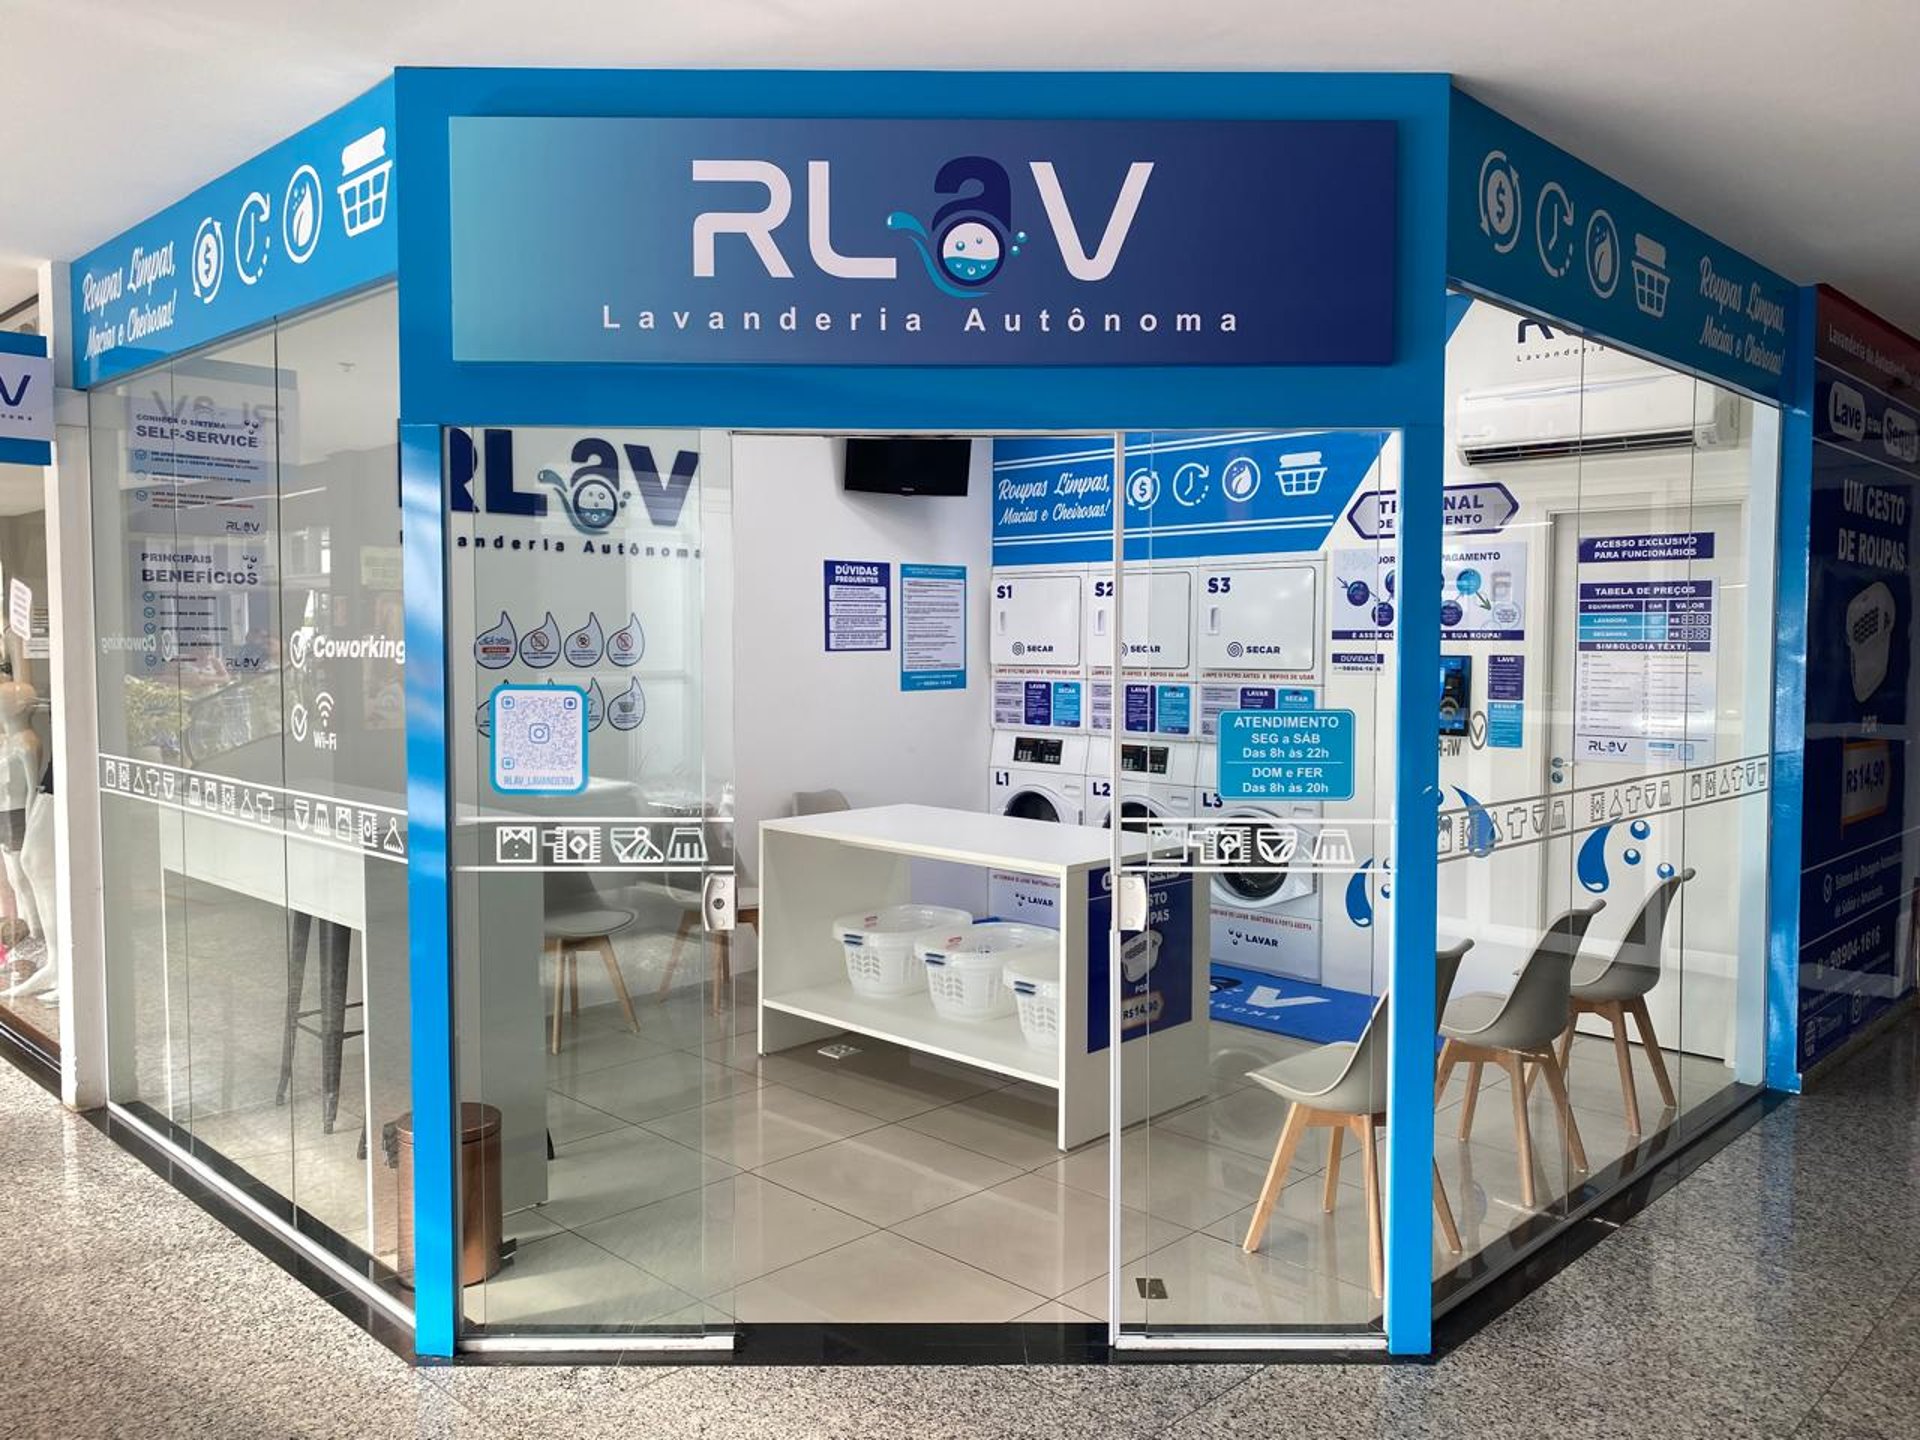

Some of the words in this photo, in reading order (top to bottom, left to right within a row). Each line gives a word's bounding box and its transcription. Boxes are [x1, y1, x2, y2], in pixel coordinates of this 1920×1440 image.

[602, 304, 922, 332] Lavanderia
[963, 305, 1237, 333] Autônoma
[1834, 393, 1861, 430] Lave
[136, 424, 259, 448] SELF-SERVICE
[998, 478, 1048, 504] Roupas
[1053, 472, 1110, 499] Limpas,
[1842, 478, 1864, 515] UM
[1866, 486, 1906, 526] CESTO
[998, 506, 1039, 525] Macias
[1041, 509, 1049, 521] e
[1052, 498, 1111, 521] Cheirosas!
[1595, 540, 1636, 549] ACESSO
[1637, 536, 1698, 546] EXCLUSIVO
[1837, 527, 1857, 562] DE
[1857, 532, 1906, 573] ROUPAS
[141, 552, 212, 564] PRINCIPAIS
[1594, 551, 1619, 559] PARA
[1621, 547, 1697, 558] FUNCIONÁRIOS
[141, 568, 258, 585] BENEFÍCIOS
[835, 563, 879, 575] DÚVIDAS
[996, 585, 1012, 599] S1
[1094, 581, 1114, 597] S2
[1207, 577, 1231, 593] S3
[1595, 587, 1634, 595] TABELA
[1636, 587, 1651, 595] DE
[1653, 586, 1696, 596] PREÇOS
[313, 635, 406, 664] Coworking
[1246, 645, 1281, 654] SECAR
[1233, 716, 1339, 728] ATENDIMENTO
[313, 731, 337, 750] Wi-Fi
[1251, 733, 1279, 744] SEG
[1282, 736, 1290, 744] a
[1293, 730, 1321, 744] SÁB
[1242, 748, 1266, 758] Das
[1269, 748, 1285, 758] 8h
[1306, 748, 1329, 758] 22h
[995, 771, 1009, 786] L1
[1251, 767, 1282, 778] DOM
[1286, 769, 1294, 778] e
[1296, 767, 1323, 778] FER
[1092, 782, 1111, 797] L2
[1242, 782, 1266, 793] Das
[1269, 782, 1285, 793] 8h
[1306, 782, 1329, 793] 20h
[1202, 792, 1224, 808] L3
[1028, 896, 1054, 906] LAVAR
[1245, 934, 1279, 947] LAVAR
